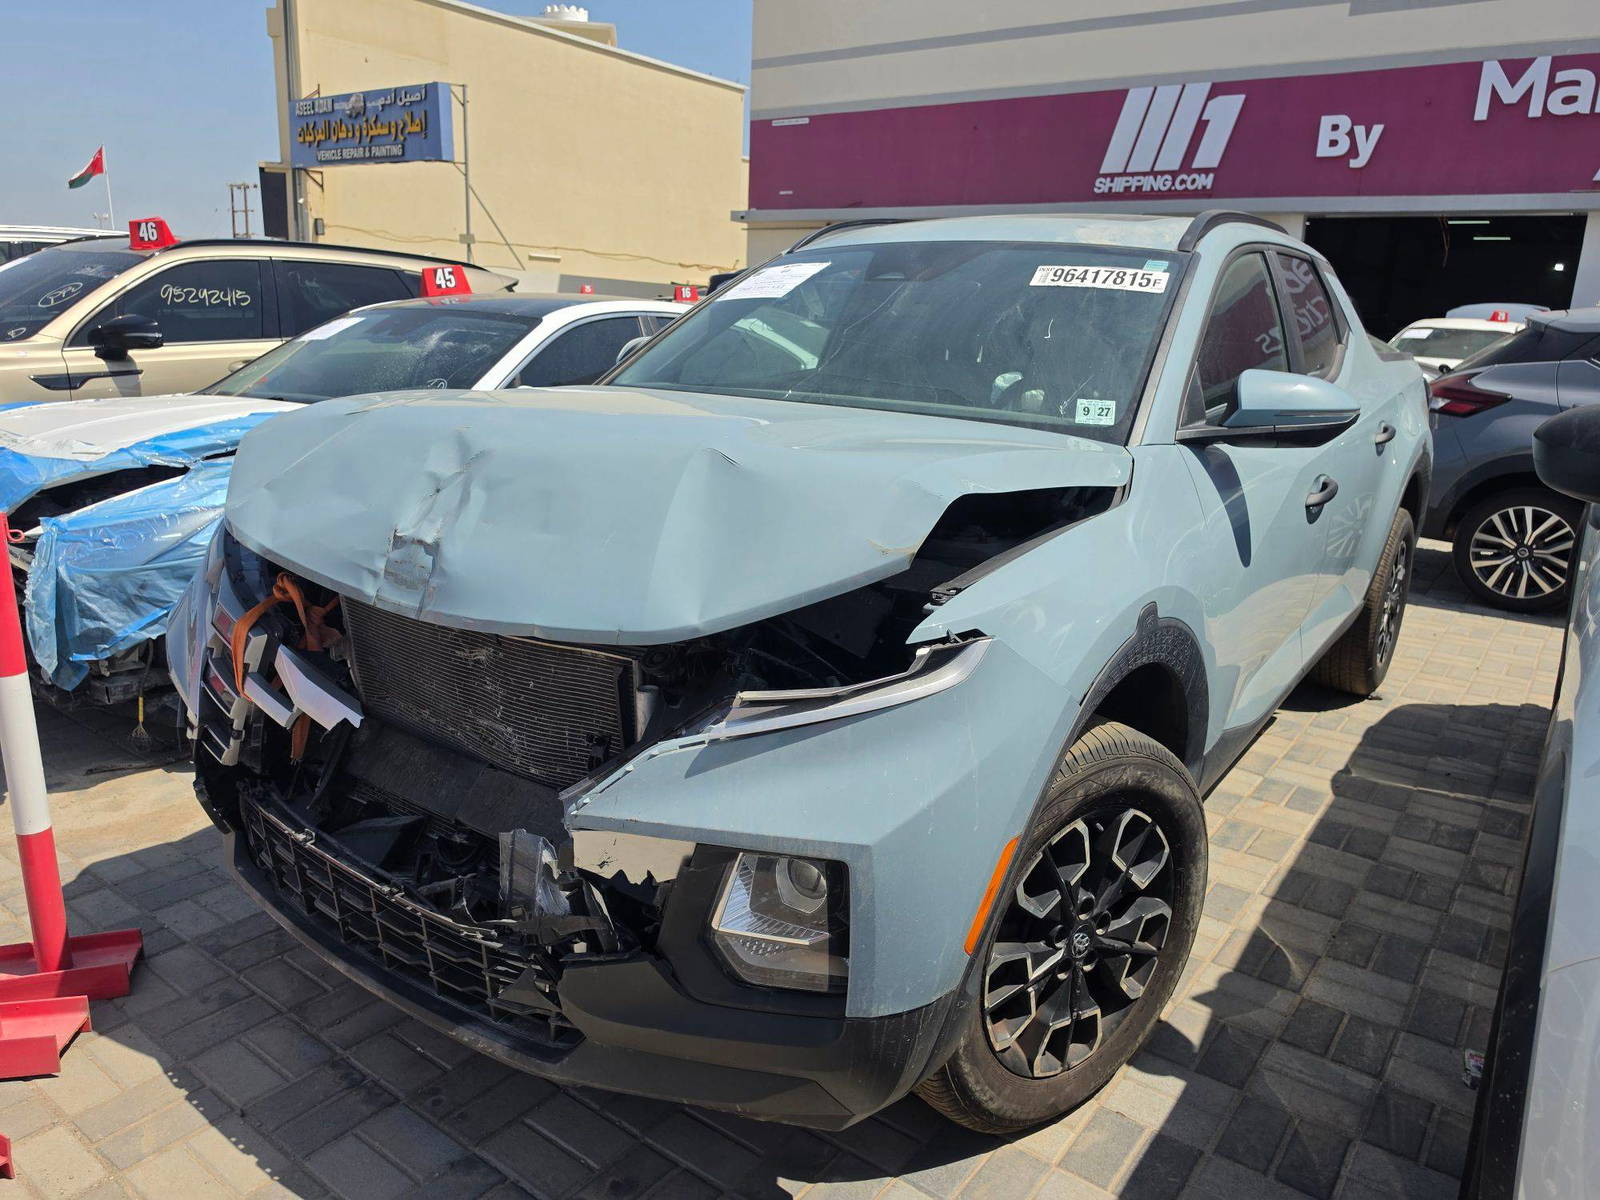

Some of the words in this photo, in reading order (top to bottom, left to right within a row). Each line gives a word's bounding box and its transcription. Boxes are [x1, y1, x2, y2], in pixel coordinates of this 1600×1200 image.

[297, 120, 330, 146] المركبات
[1316, 114, 1384, 168] By
[317, 149, 342, 160] VEHICLE
[342, 147, 364, 158] REPAIR
[365, 146, 371, 158] &
[371, 144, 402, 157] PAINTING
[1094, 173, 1215, 193] SHIPPING.COM
[139, 222, 158, 242] 46
[435, 267, 456, 289] 45
[1050, 268, 1153, 287] 96417815
[1152, 279, 1162, 287] F
[681, 287, 691, 298] 16
[1083, 406, 1090, 416] 9
[1097, 407, 1111, 416] 27
